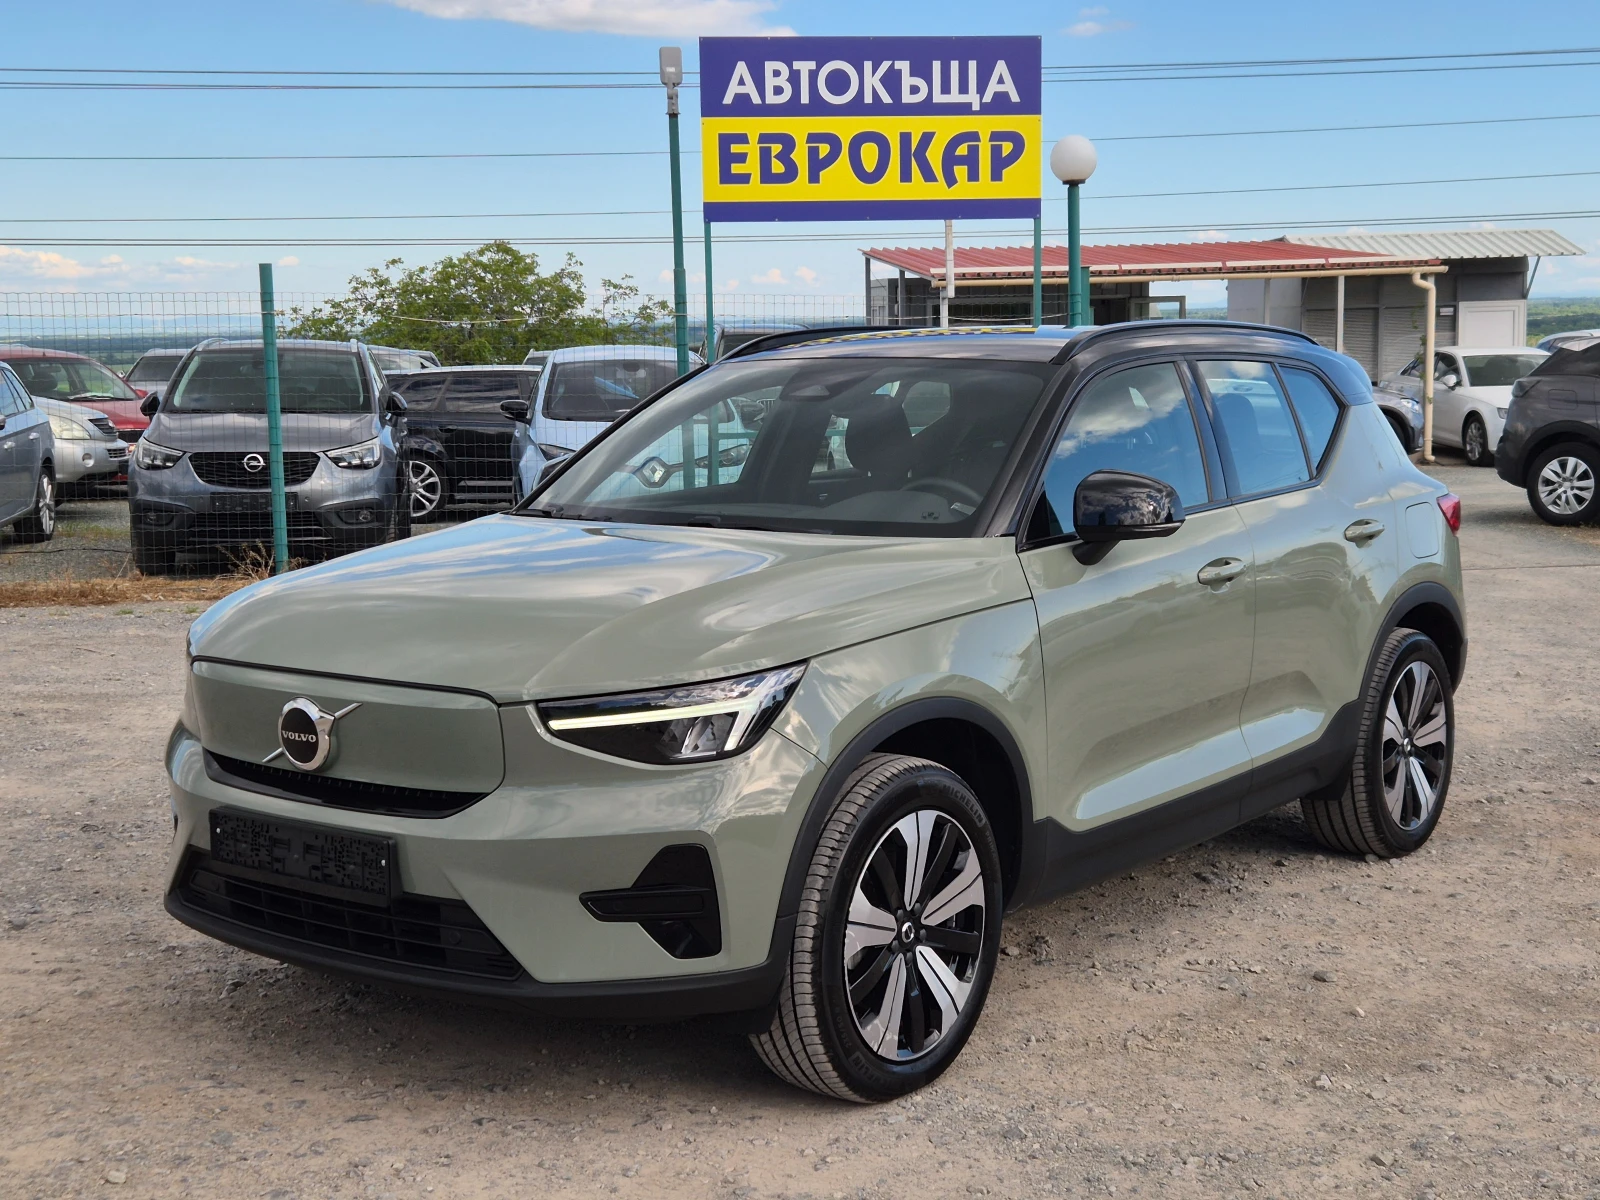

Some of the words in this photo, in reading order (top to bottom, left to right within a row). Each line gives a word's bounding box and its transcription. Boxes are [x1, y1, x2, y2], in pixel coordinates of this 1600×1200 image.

[722, 59, 1021, 111] АВТОКЪЩА
[717, 130, 1026, 190] ЕВРОКАР
[282, 730, 317, 742] VOLVO
[943, 784, 984, 824] MICHELIN
